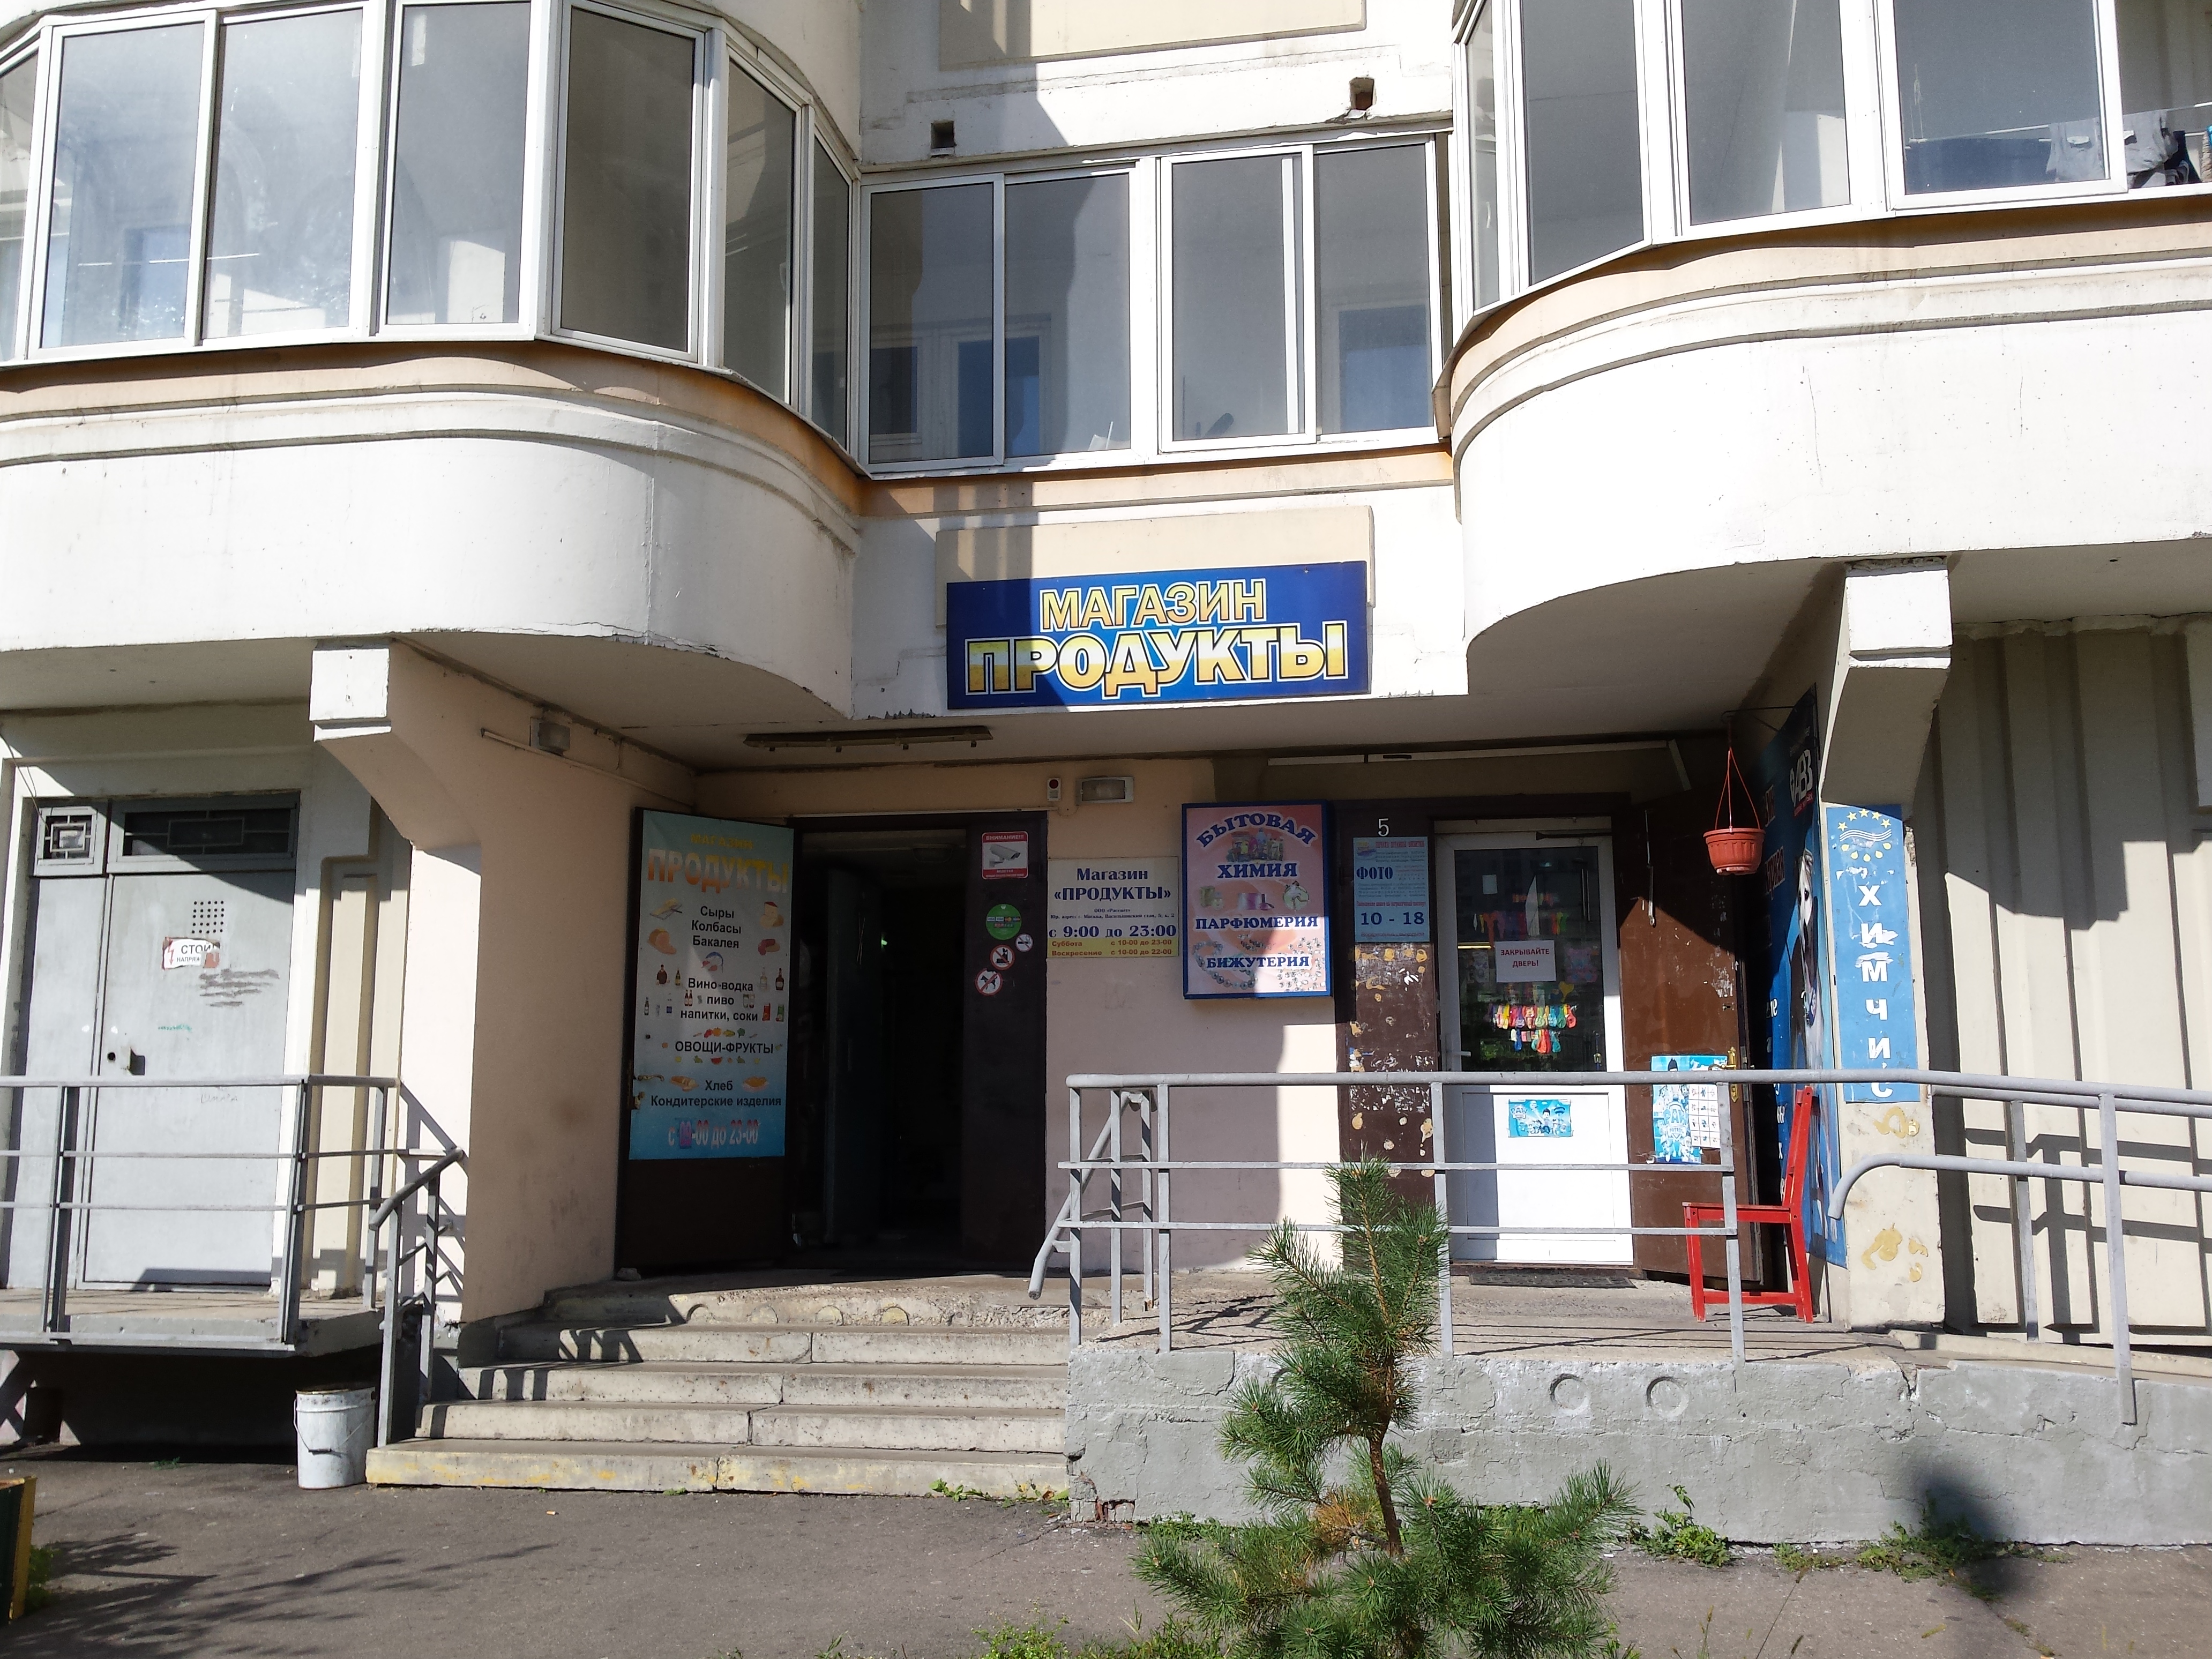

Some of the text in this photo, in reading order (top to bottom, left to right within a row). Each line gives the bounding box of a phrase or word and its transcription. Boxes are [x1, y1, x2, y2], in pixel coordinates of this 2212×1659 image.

[1040, 578, 1267, 632] МАГАЗИН
[966, 621, 1348, 699] ПРОДУКТЫ
[1196, 813, 1316, 847] БЫТОВАЯ
[1378, 818, 1389, 837] 5
[647, 848, 789, 894] ПРОДУКТЫ
[1077, 868, 1148, 880] Магазин
[1217, 863, 1297, 878] ХИМИЯ
[1356, 866, 1393, 880] ФОТО
[1054, 886, 1171, 901] «ПРОДУКТЫ»
[700, 906, 734, 920] Сыры
[1361, 912, 1382, 925] 10
[1403, 911, 1424, 925] 18
[691, 920, 741, 933] Колбасы
[1195, 916, 1318, 929] ПАРФЮМЕРИЯ
[1049, 925, 1177, 938] с 9:00 до 23:00
[693, 935, 739, 948] Бакалея
[1500, 947, 1550, 956] ЗАКРЫВАЙТЕ
[1206, 956, 1310, 968] БИЖУТЕРИЯ
[1512, 960, 1539, 968] ДВЕРЬ!
[707, 996, 735, 1005] пиво
[681, 1010, 758, 1022] напитки, соки
[675, 1041, 773, 1054] ОВОЩИ-ФРУКТЫ
[705, 1080, 733, 1092] Хлеб
[651, 1095, 781, 1108] Кондитерские изделия
